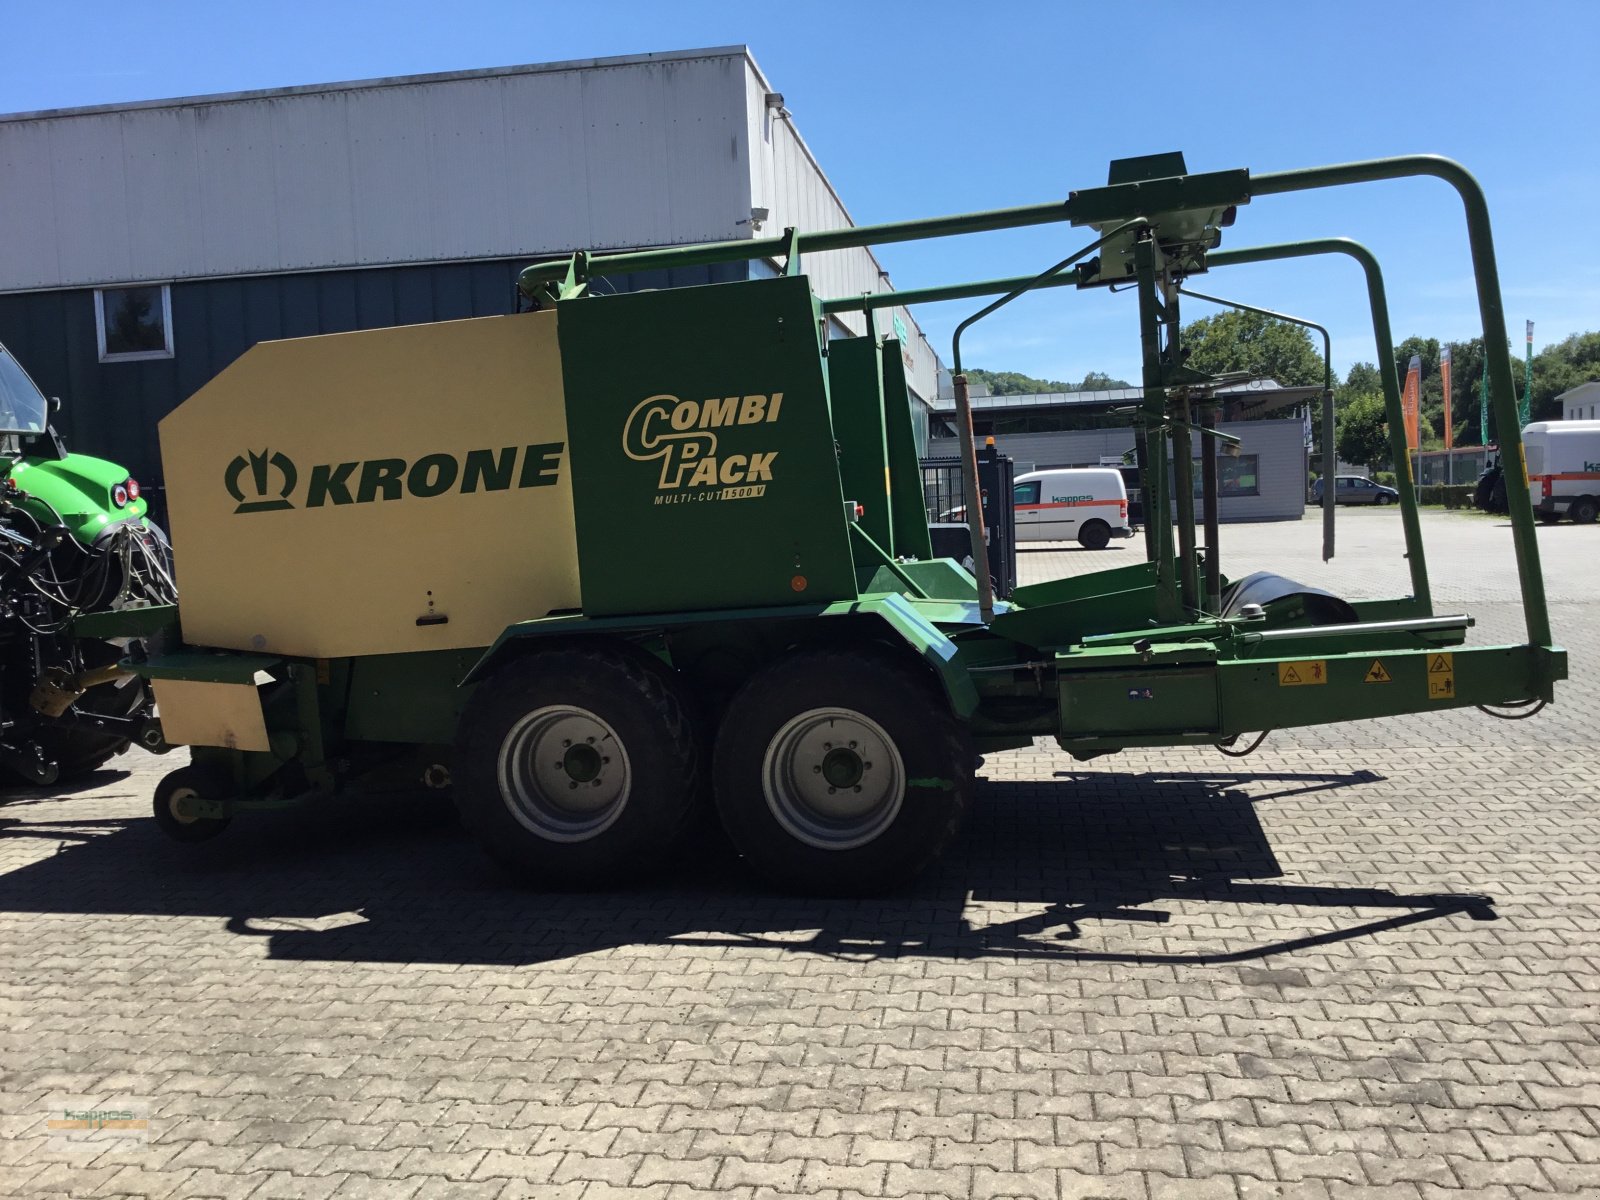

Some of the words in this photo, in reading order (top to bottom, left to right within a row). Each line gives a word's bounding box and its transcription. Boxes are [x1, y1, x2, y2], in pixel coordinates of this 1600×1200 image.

[622, 393, 784, 461] COMBI
[305, 441, 565, 508] KRONE
[658, 432, 779, 489] PACK
[654, 490, 722, 505] MULTI-CUT
[724, 487, 753, 499] 1500
[756, 486, 765, 496] V
[1052, 495, 1094, 507] kappes
